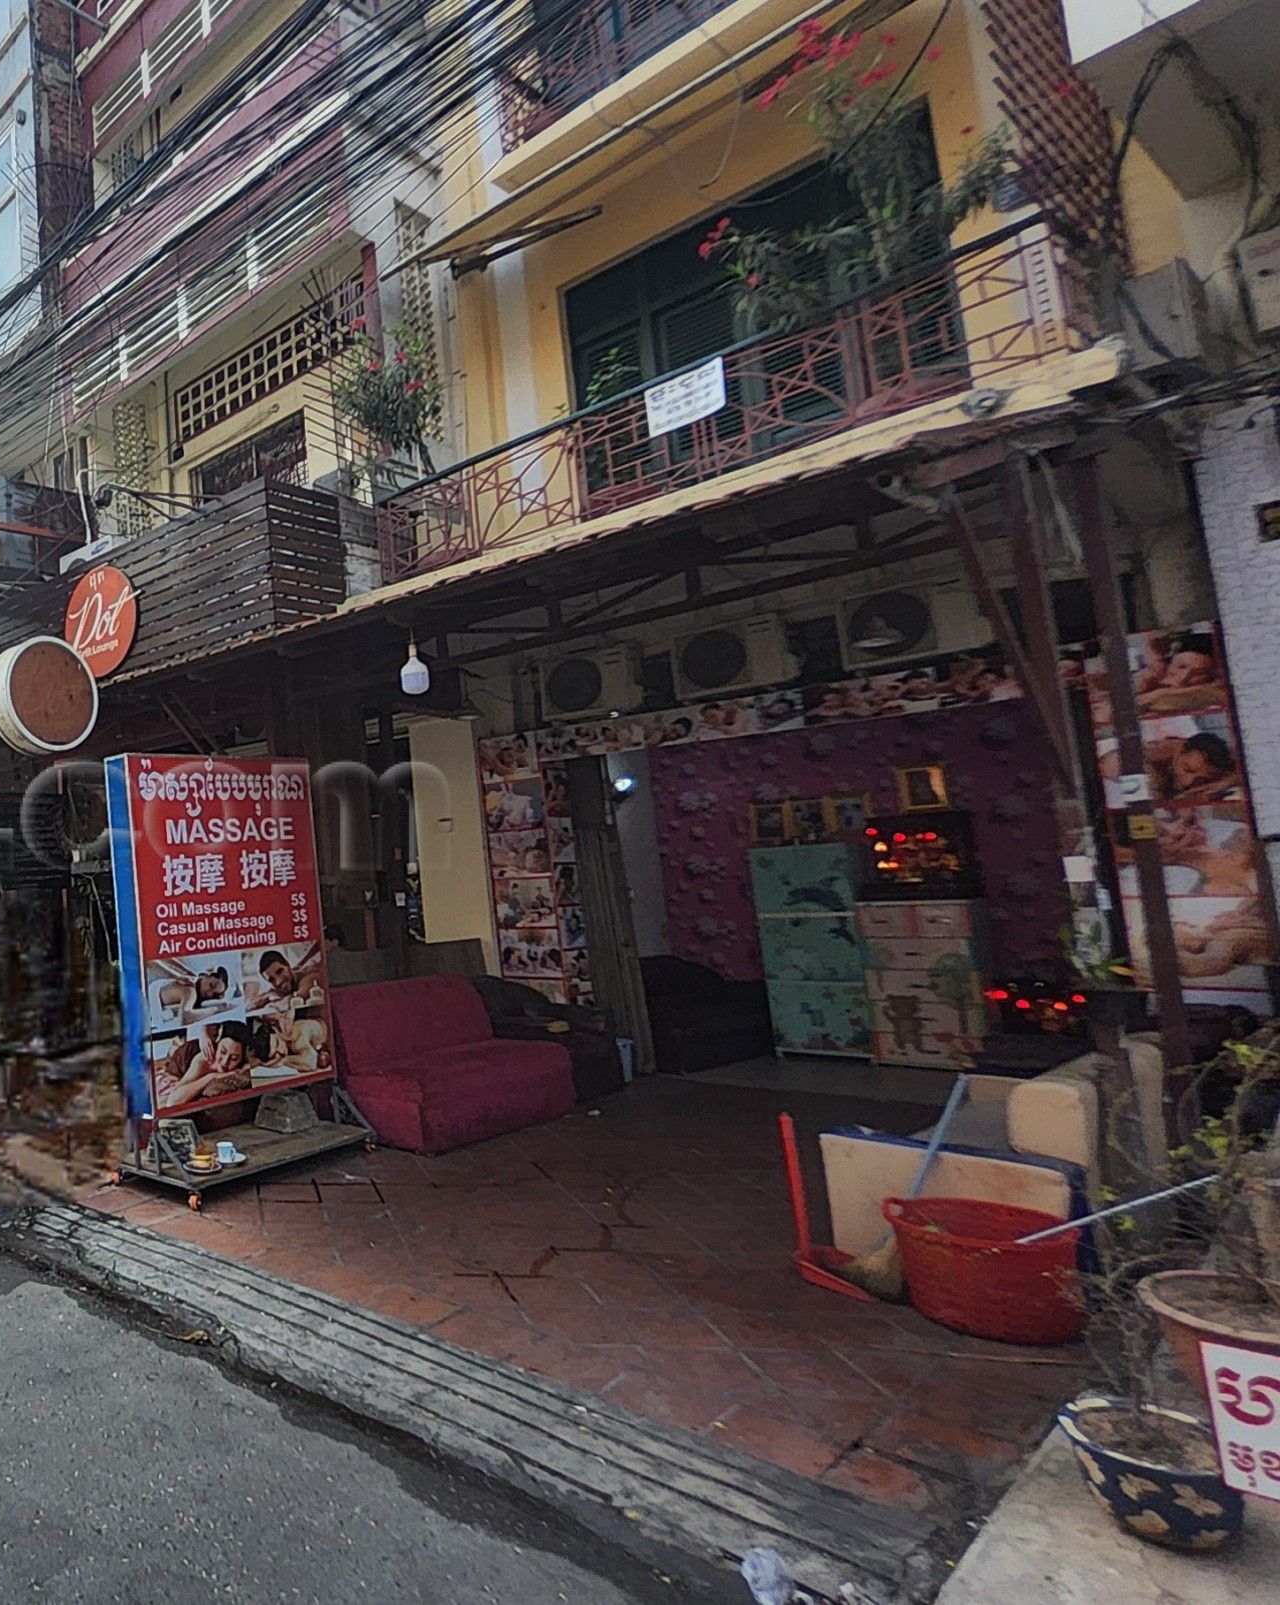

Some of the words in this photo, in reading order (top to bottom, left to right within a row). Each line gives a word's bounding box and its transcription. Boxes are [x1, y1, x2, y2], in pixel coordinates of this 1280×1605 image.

[165, 817, 295, 845] MASSAGE
[162, 852, 226, 897] 按摩
[239, 847, 297, 890] 按摩
[155, 903, 177, 918] Oil
[182, 901, 246, 916] Massage
[290, 892, 306, 907] 5$
[157, 918, 209, 936] Casual
[213, 914, 274, 931] Massage
[291, 908, 308, 923] 3$
[158, 940, 182, 955] Air
[185, 930, 276, 951] Conditioning
[293, 924, 309, 939] 5$
